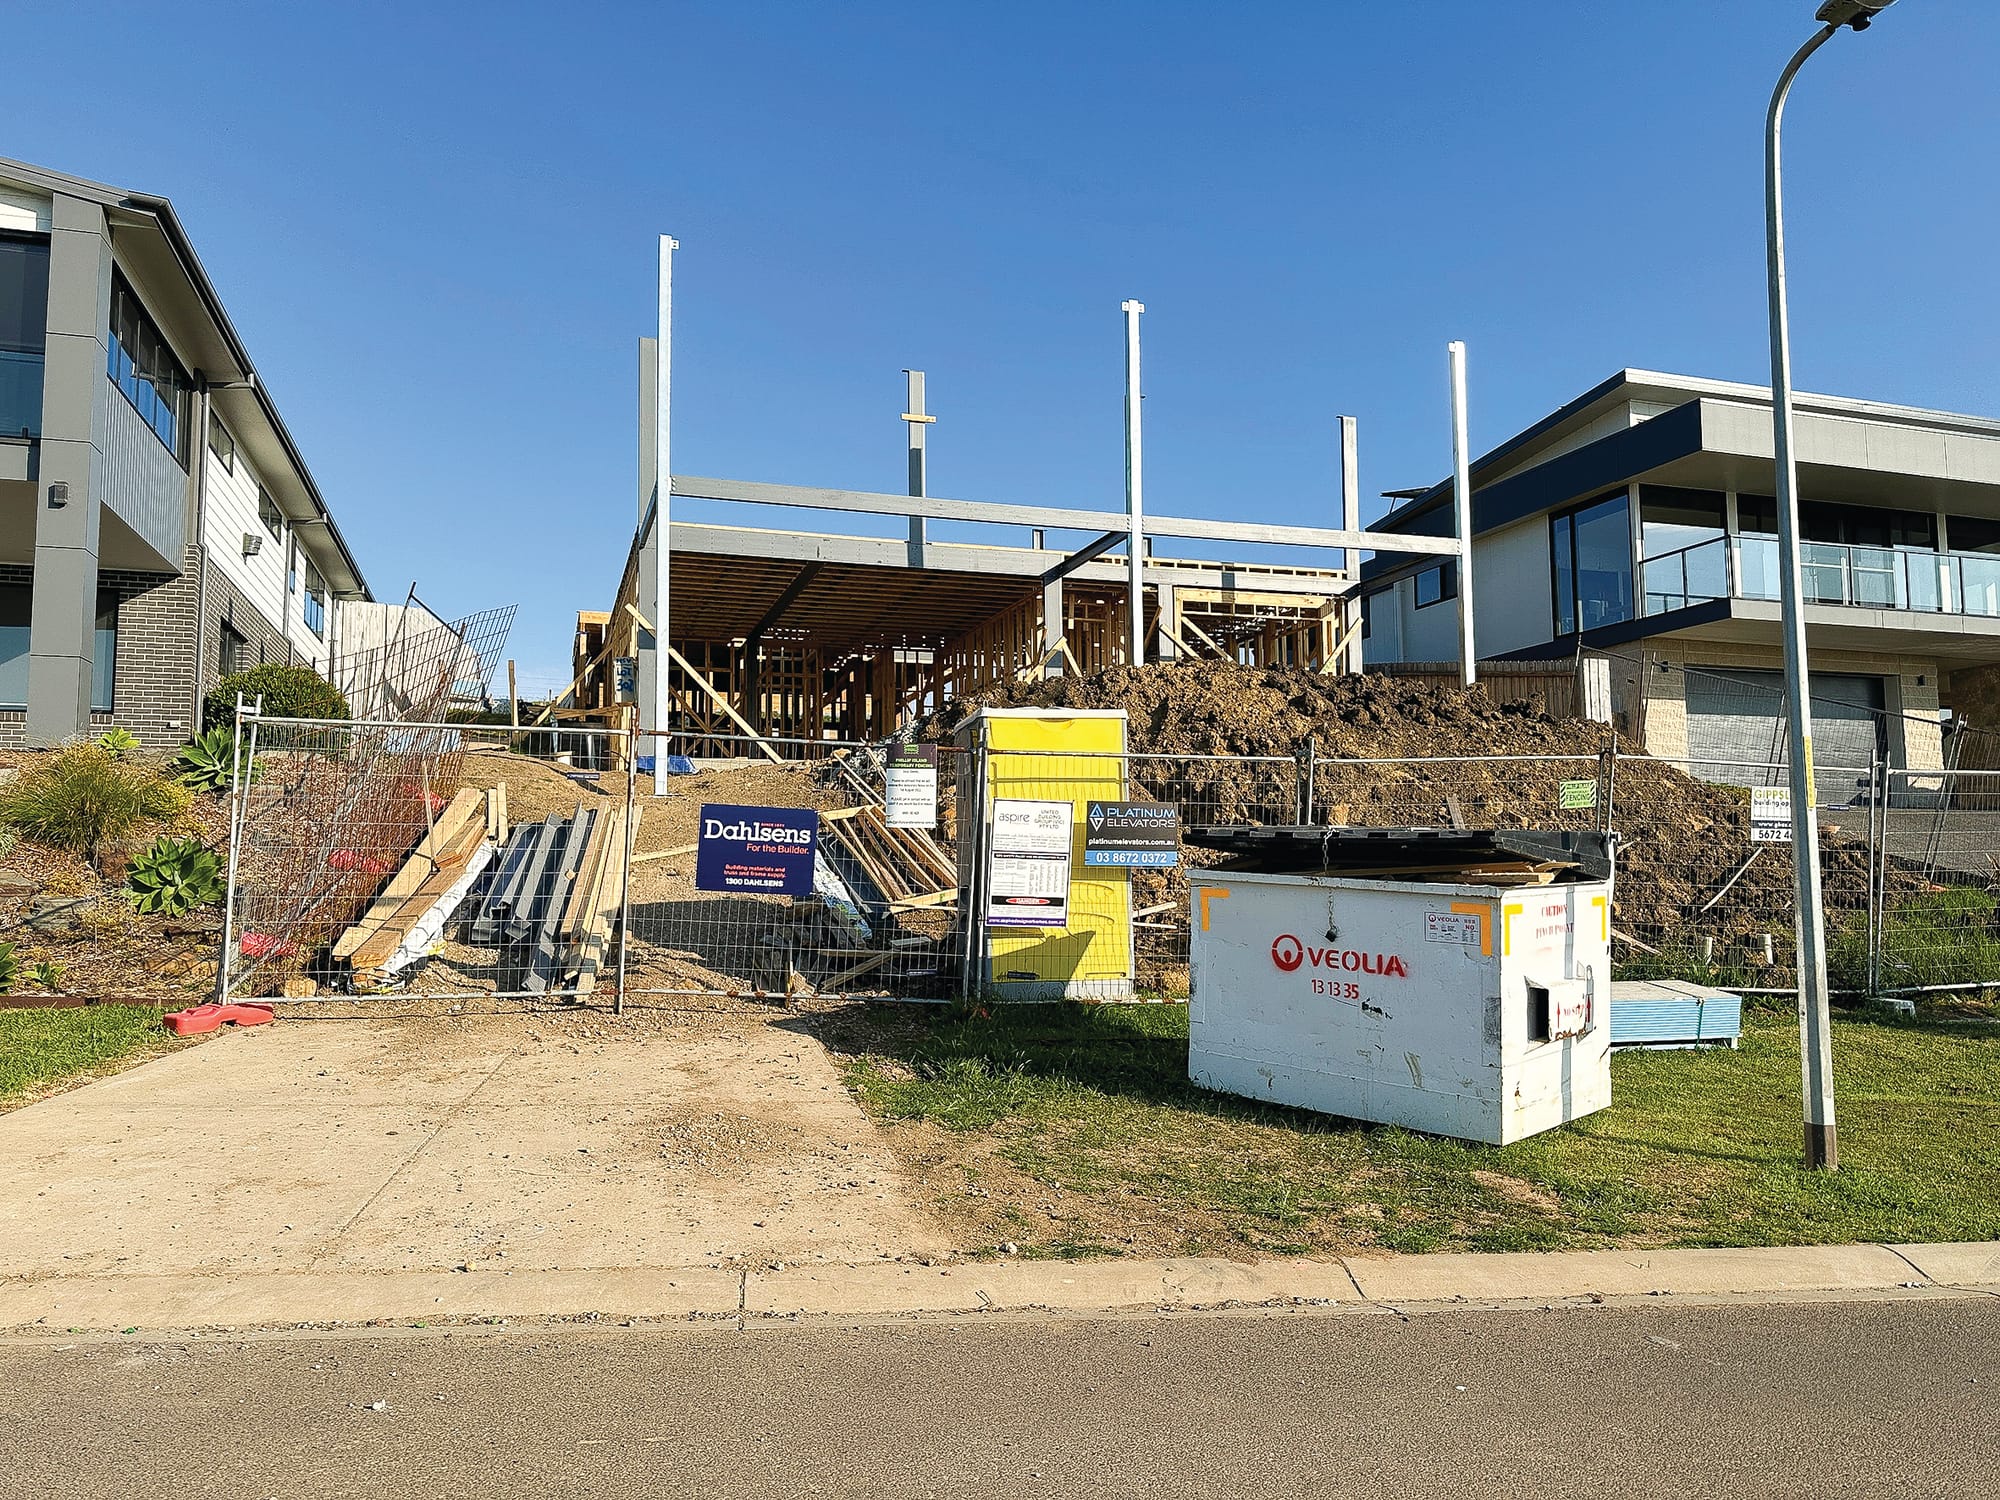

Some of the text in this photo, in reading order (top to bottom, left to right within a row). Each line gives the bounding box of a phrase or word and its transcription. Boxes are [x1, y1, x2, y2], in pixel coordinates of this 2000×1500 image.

[1754, 799, 1780, 808] building
[1107, 808, 1175, 818] PLATINUM
[999, 813, 1030, 824] aspire
[1106, 818, 1176, 828] ELEVATORS
[704, 820, 811, 844] Dahlsens
[1759, 830, 1781, 840] 5672
[746, 843, 809, 854] For the Builder.
[1096, 853, 1167, 863] 03 8672 0372
[744, 879, 784, 887] DAHLSENS
[1308, 946, 1406, 978] VEOLIA
[1312, 979, 1359, 999] 13 13 35
